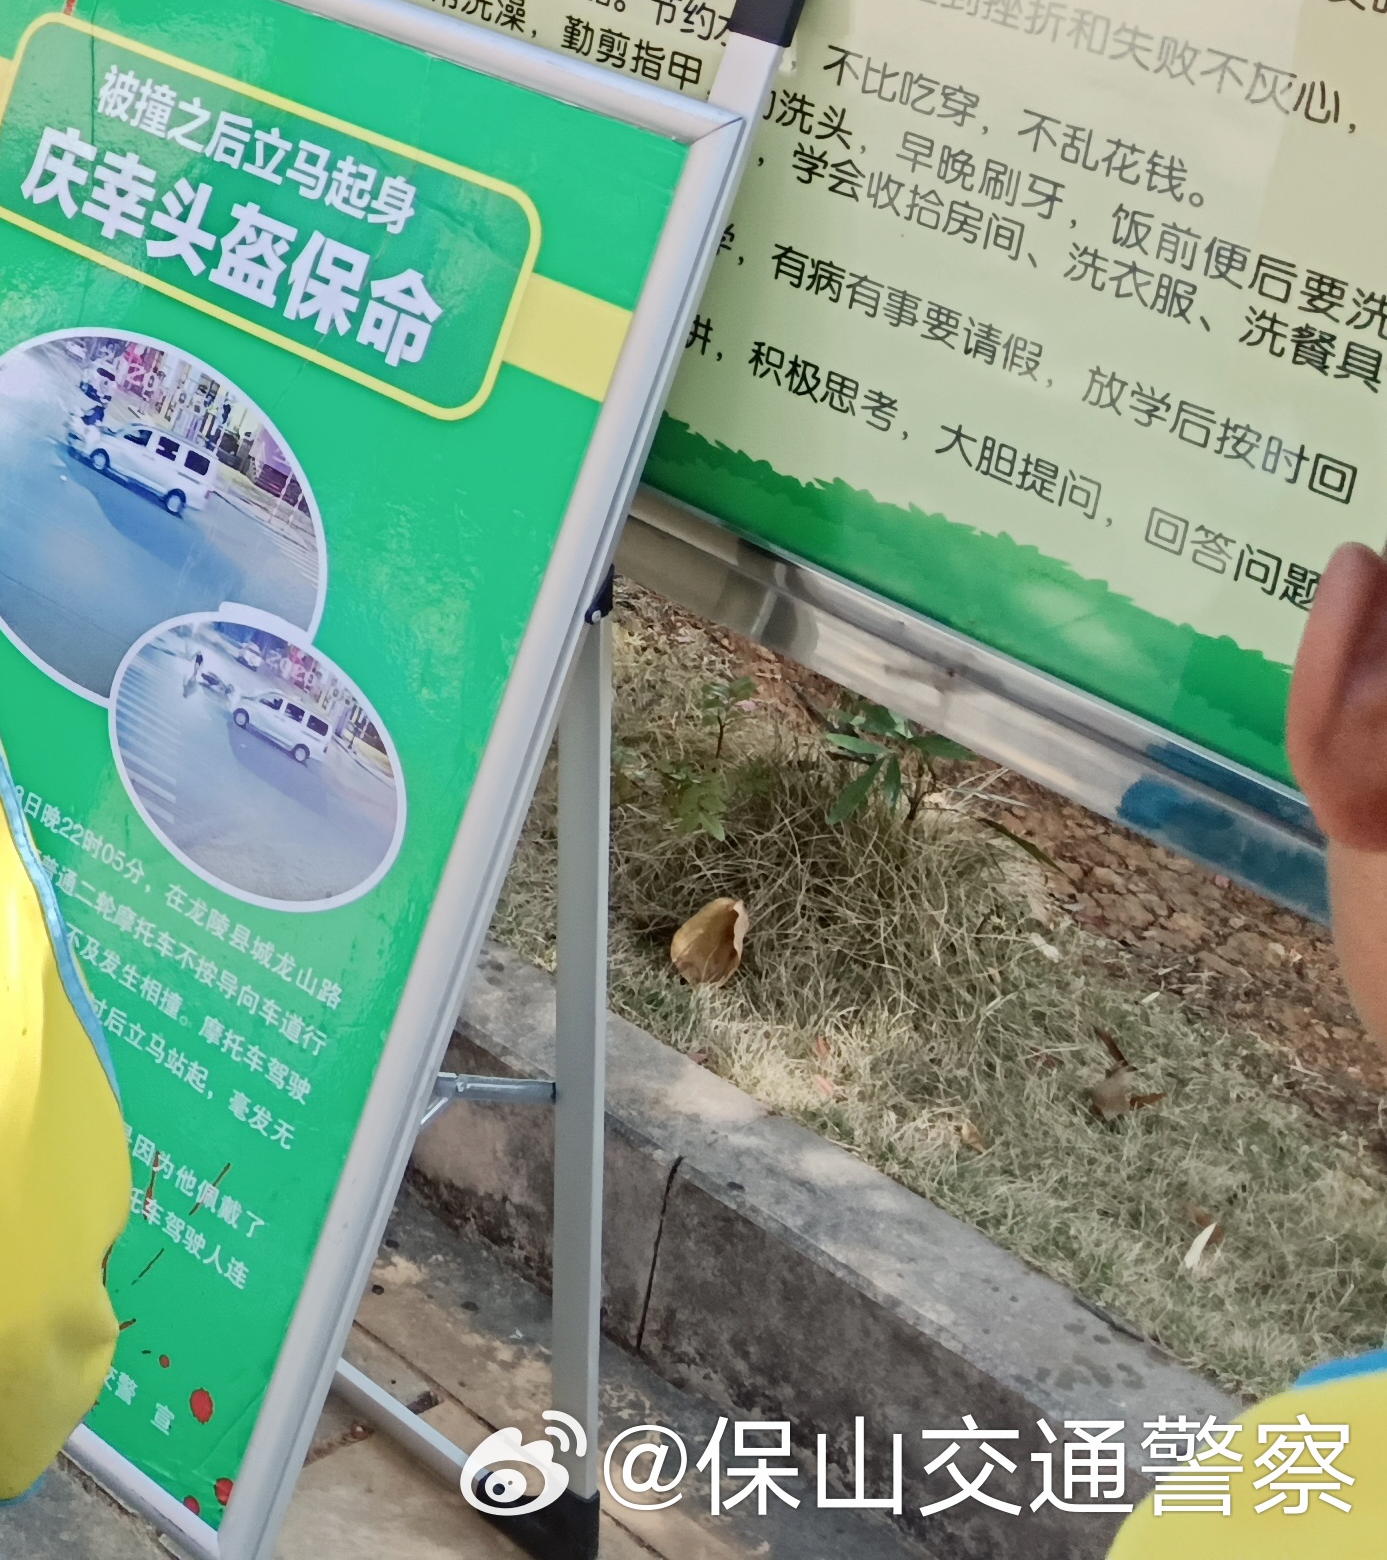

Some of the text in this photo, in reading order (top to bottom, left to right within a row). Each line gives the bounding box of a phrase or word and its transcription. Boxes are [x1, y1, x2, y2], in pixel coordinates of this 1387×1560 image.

[21, 126, 444, 369] 庆幸头盔保命
[95, 64, 417, 235] 被撞之后立马起身
[35, 849, 327, 1058] 普通二轮摩托车不按导向车道行
